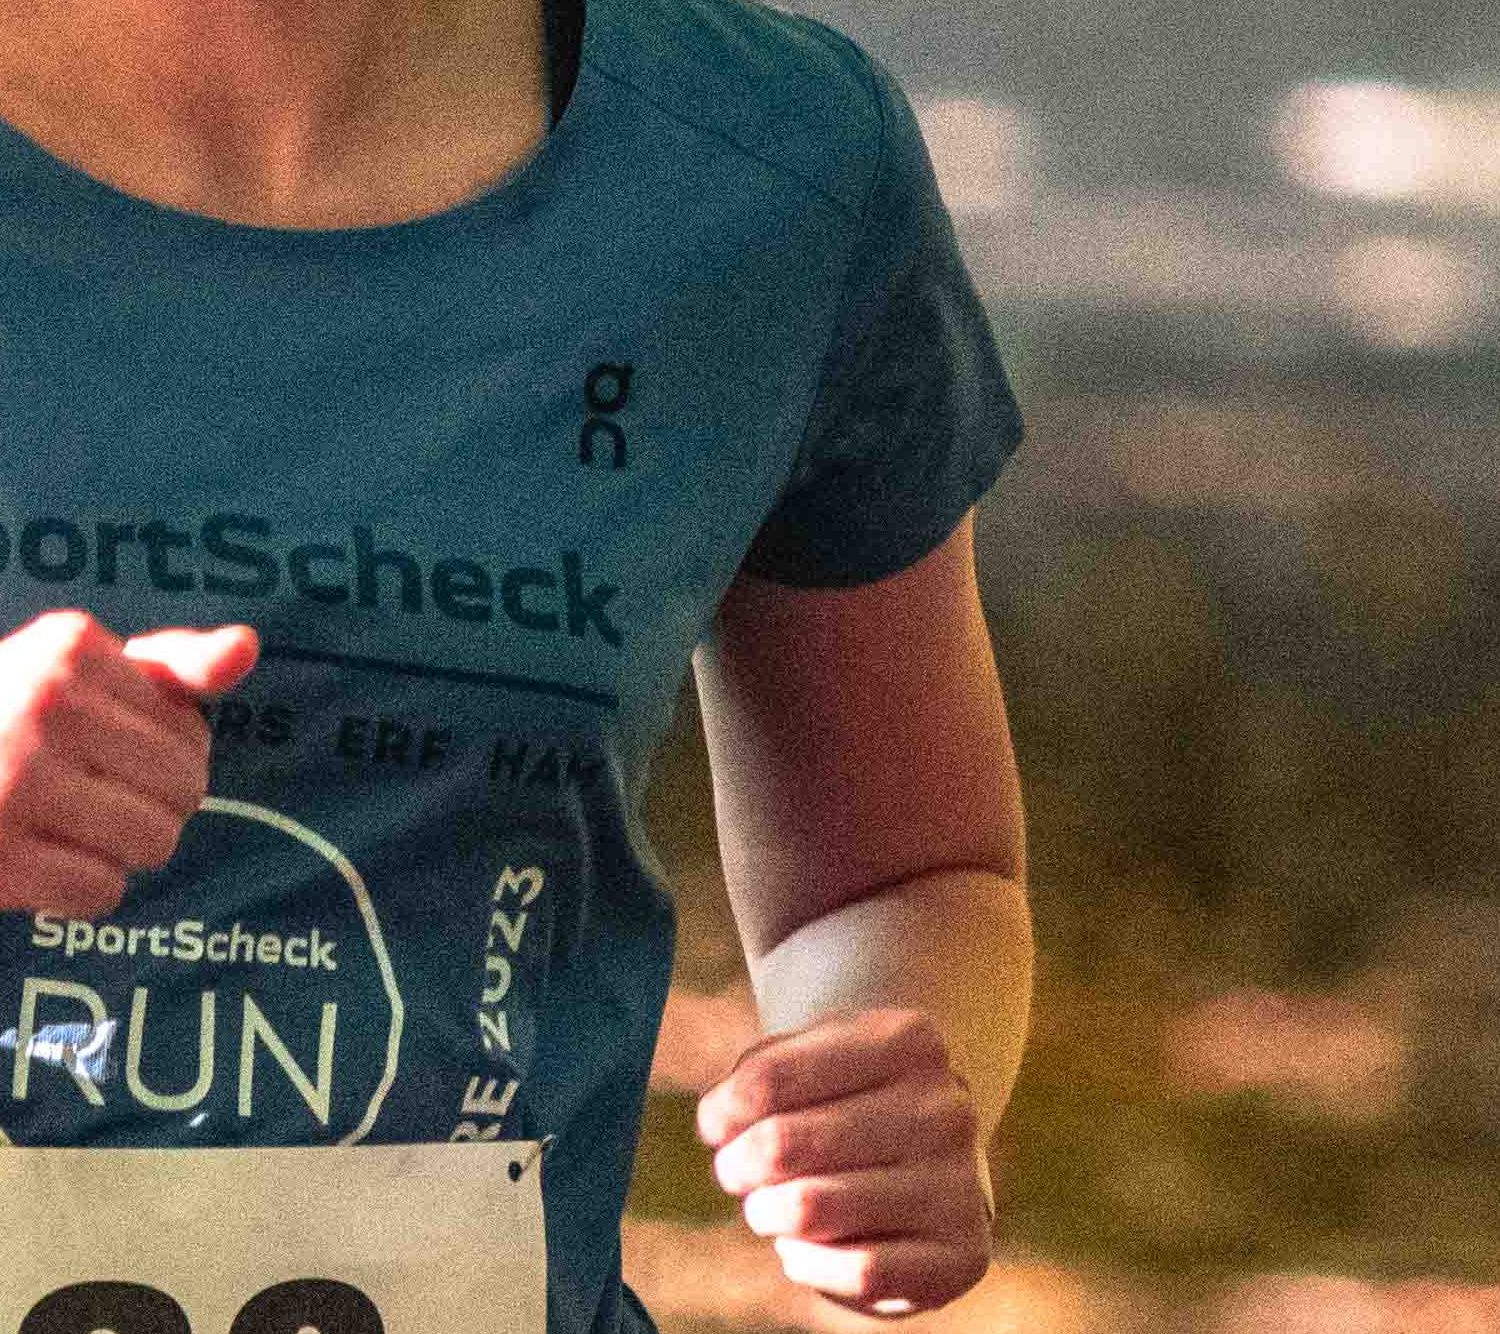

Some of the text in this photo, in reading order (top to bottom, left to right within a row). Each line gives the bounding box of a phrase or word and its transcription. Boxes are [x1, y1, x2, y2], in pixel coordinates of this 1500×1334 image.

[336, 717, 453, 770] ERF
[31, 913, 338, 970] SportScheck
[477, 864, 546, 1052] 2023
[12, 977, 338, 1126] RUN
